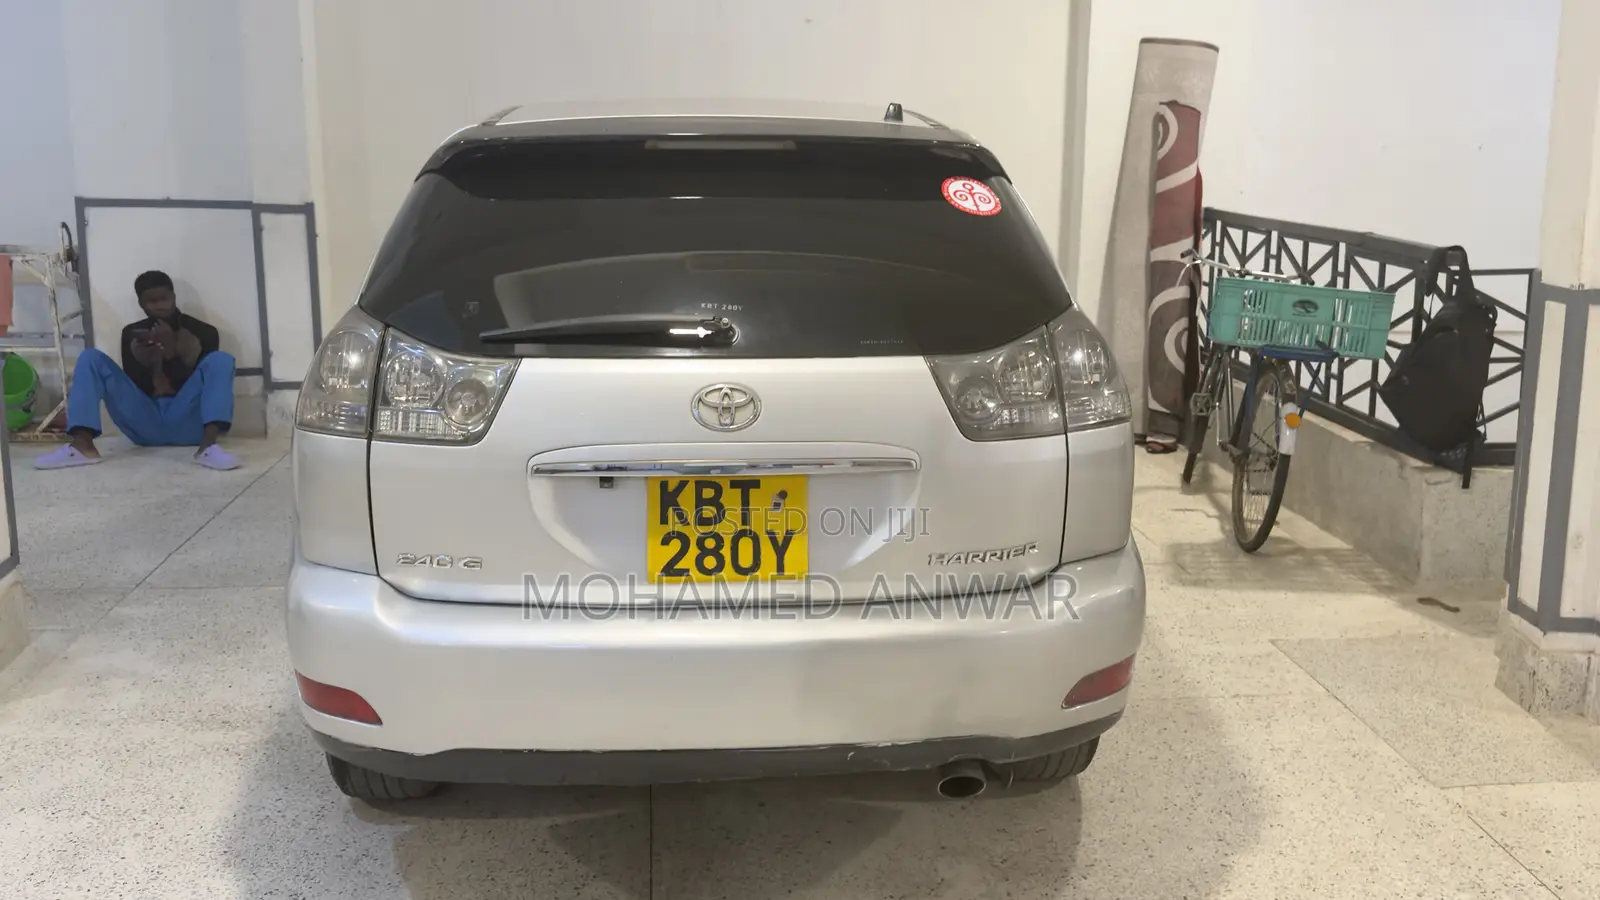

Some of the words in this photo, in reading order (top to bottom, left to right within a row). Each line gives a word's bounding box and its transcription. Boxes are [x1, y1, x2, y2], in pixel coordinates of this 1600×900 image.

[658, 479, 762, 527] KBT
[395, 552, 453, 570] 240
[457, 556, 483, 571] G
[659, 528, 797, 577] 280Y
[928, 541, 1039, 566] HARRIER
